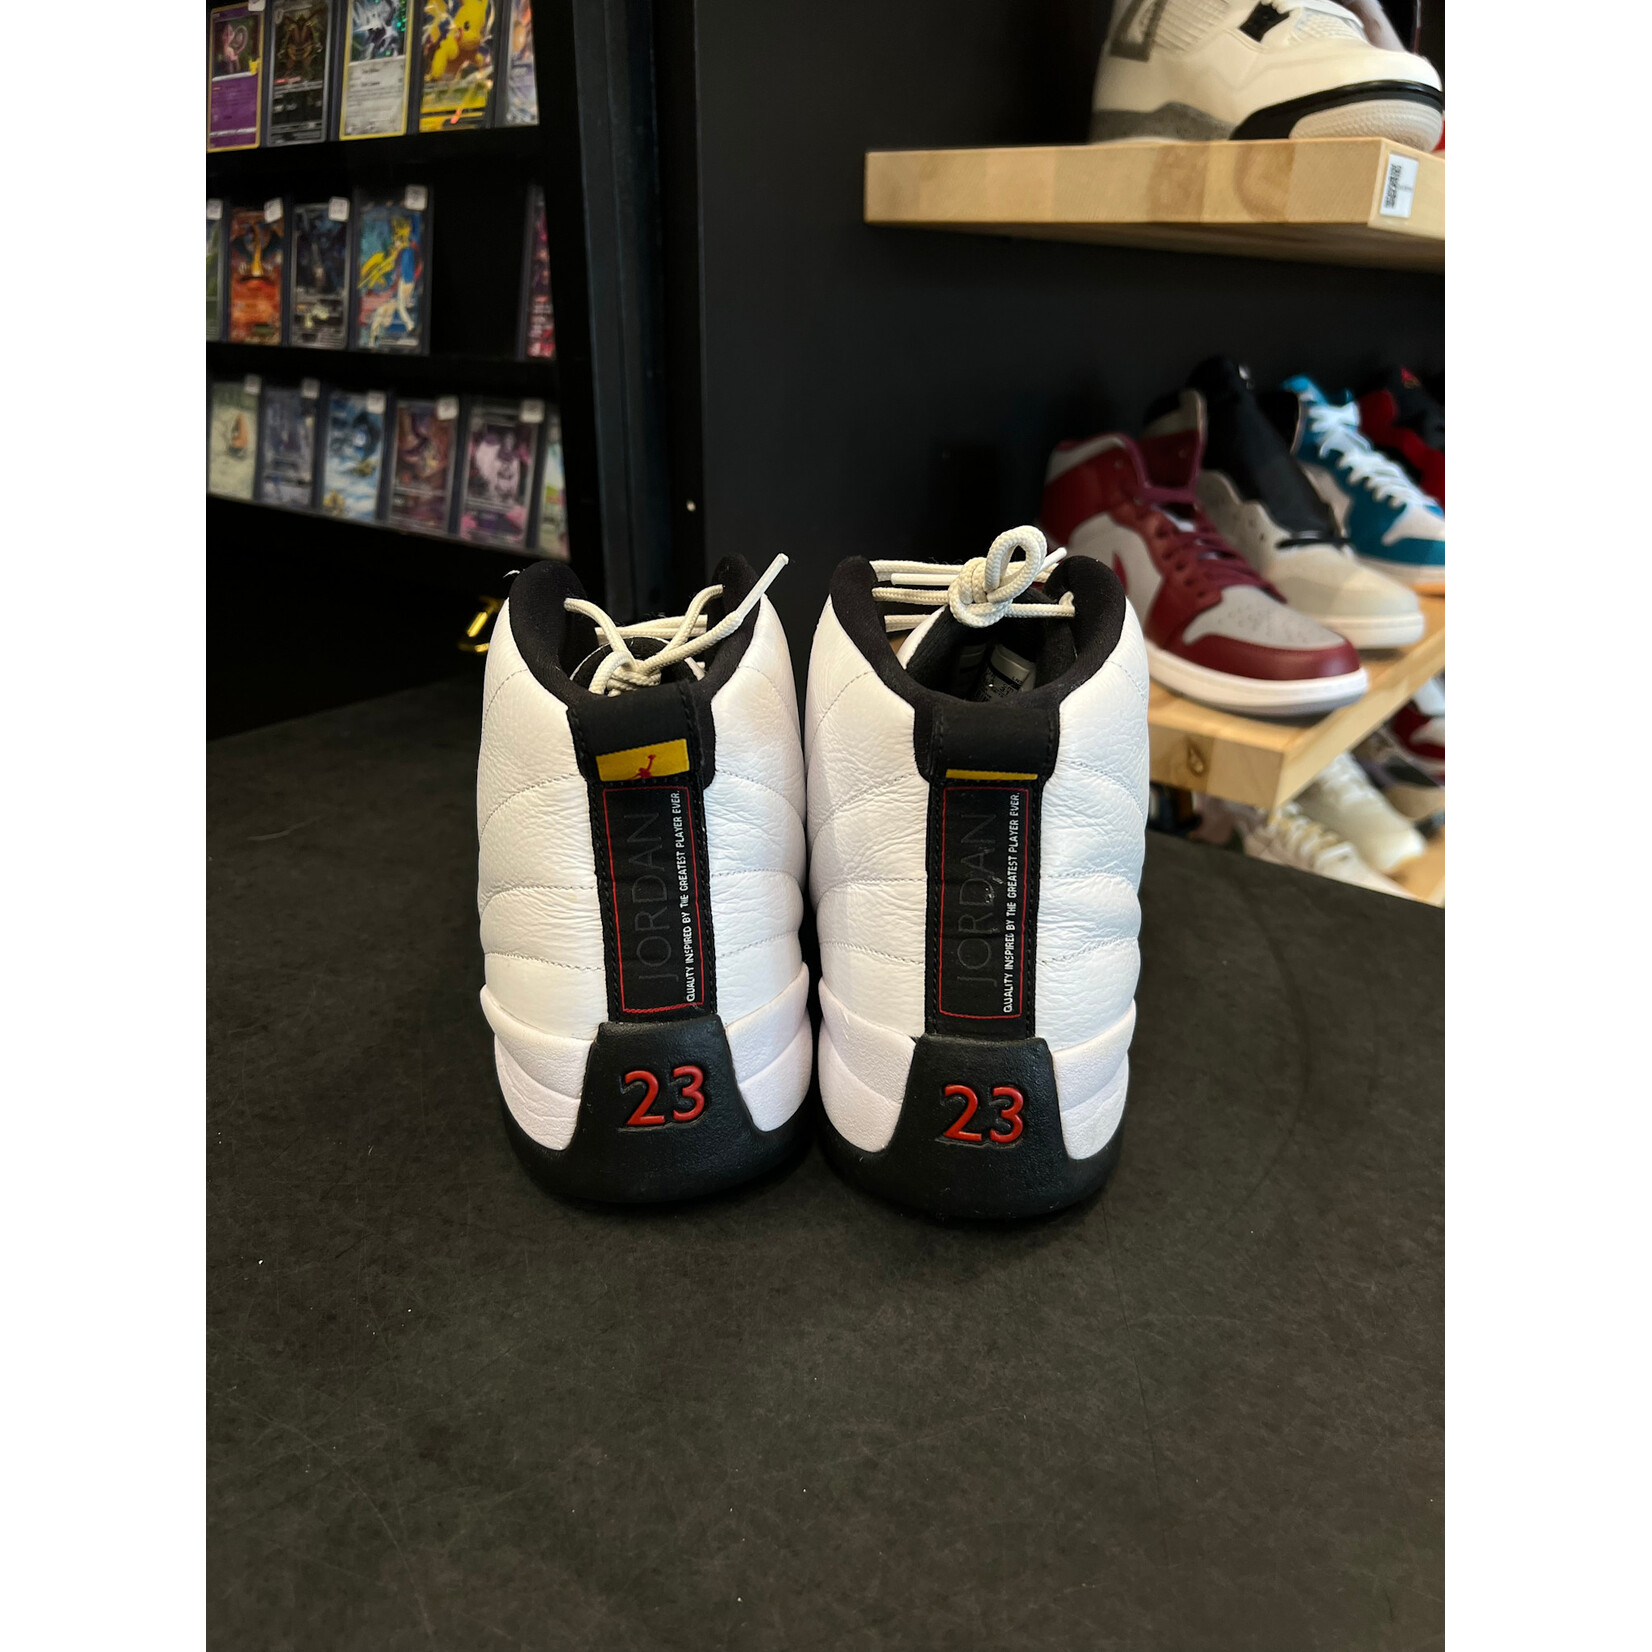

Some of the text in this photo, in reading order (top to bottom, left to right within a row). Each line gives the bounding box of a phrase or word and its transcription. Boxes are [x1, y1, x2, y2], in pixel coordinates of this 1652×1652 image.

[623, 812, 679, 982] JORDAN
[671, 790, 696, 1003] QUALITY INSPIRED BY THE GREATEST PLAYER EVER.
[957, 813, 998, 988] JORDAN
[1003, 792, 1020, 1013] QUALITY INSPIRED BY THE GREATEST PLAYER EVER.
[624, 1065, 705, 1126] 23
[943, 1084, 1024, 1143] 23
